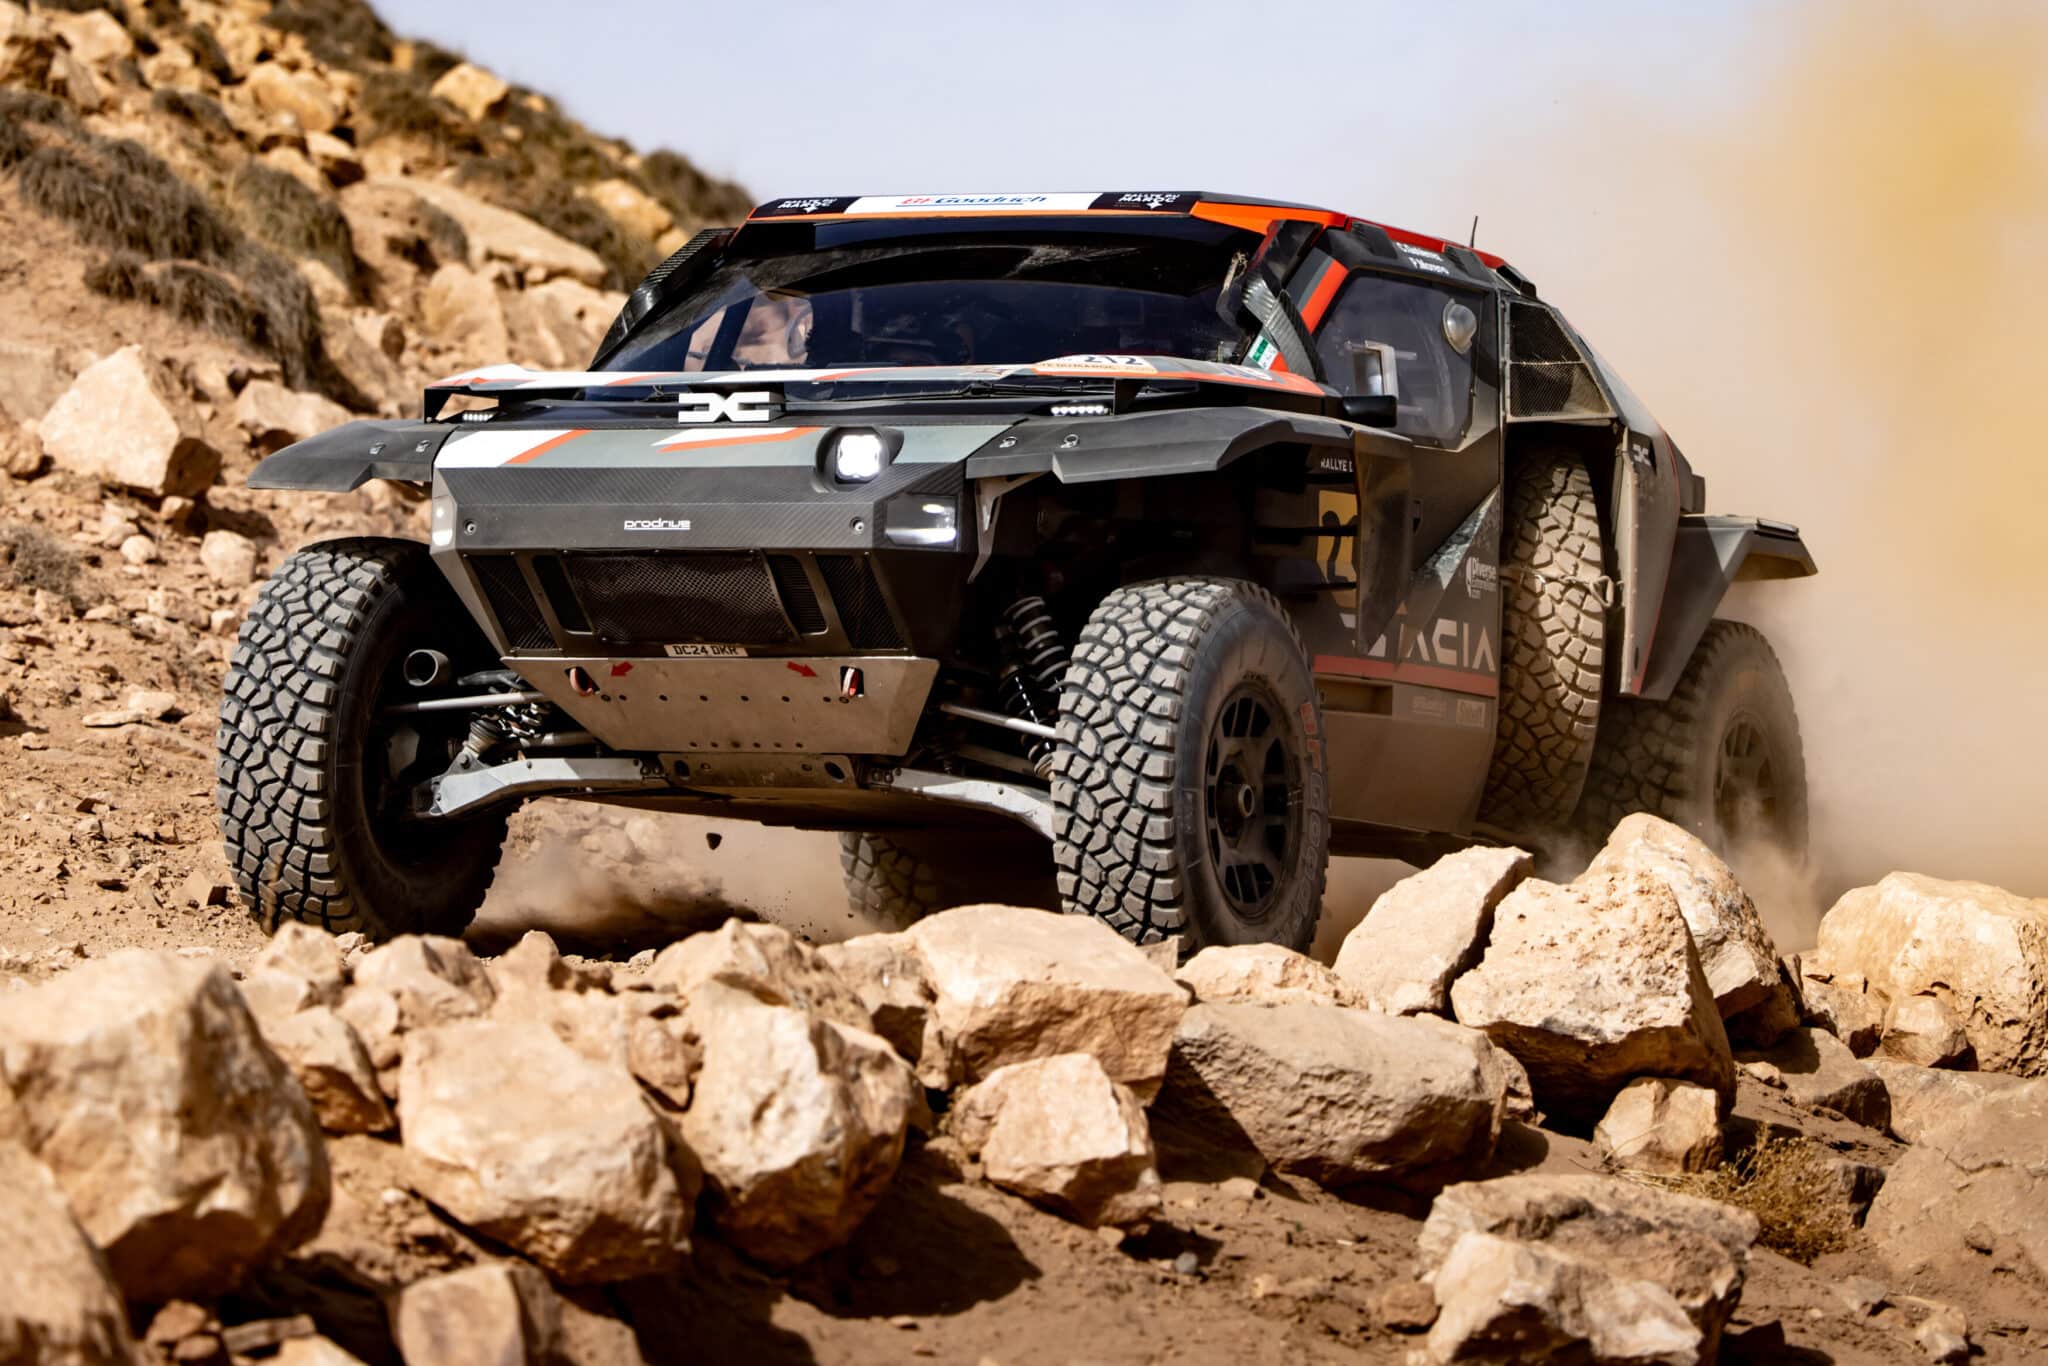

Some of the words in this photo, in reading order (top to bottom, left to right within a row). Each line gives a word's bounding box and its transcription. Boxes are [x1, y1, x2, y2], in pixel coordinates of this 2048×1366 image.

[624, 517, 691, 530] prodrive
[672, 645, 709, 656] DC24
[712, 645, 739, 656] DKR
